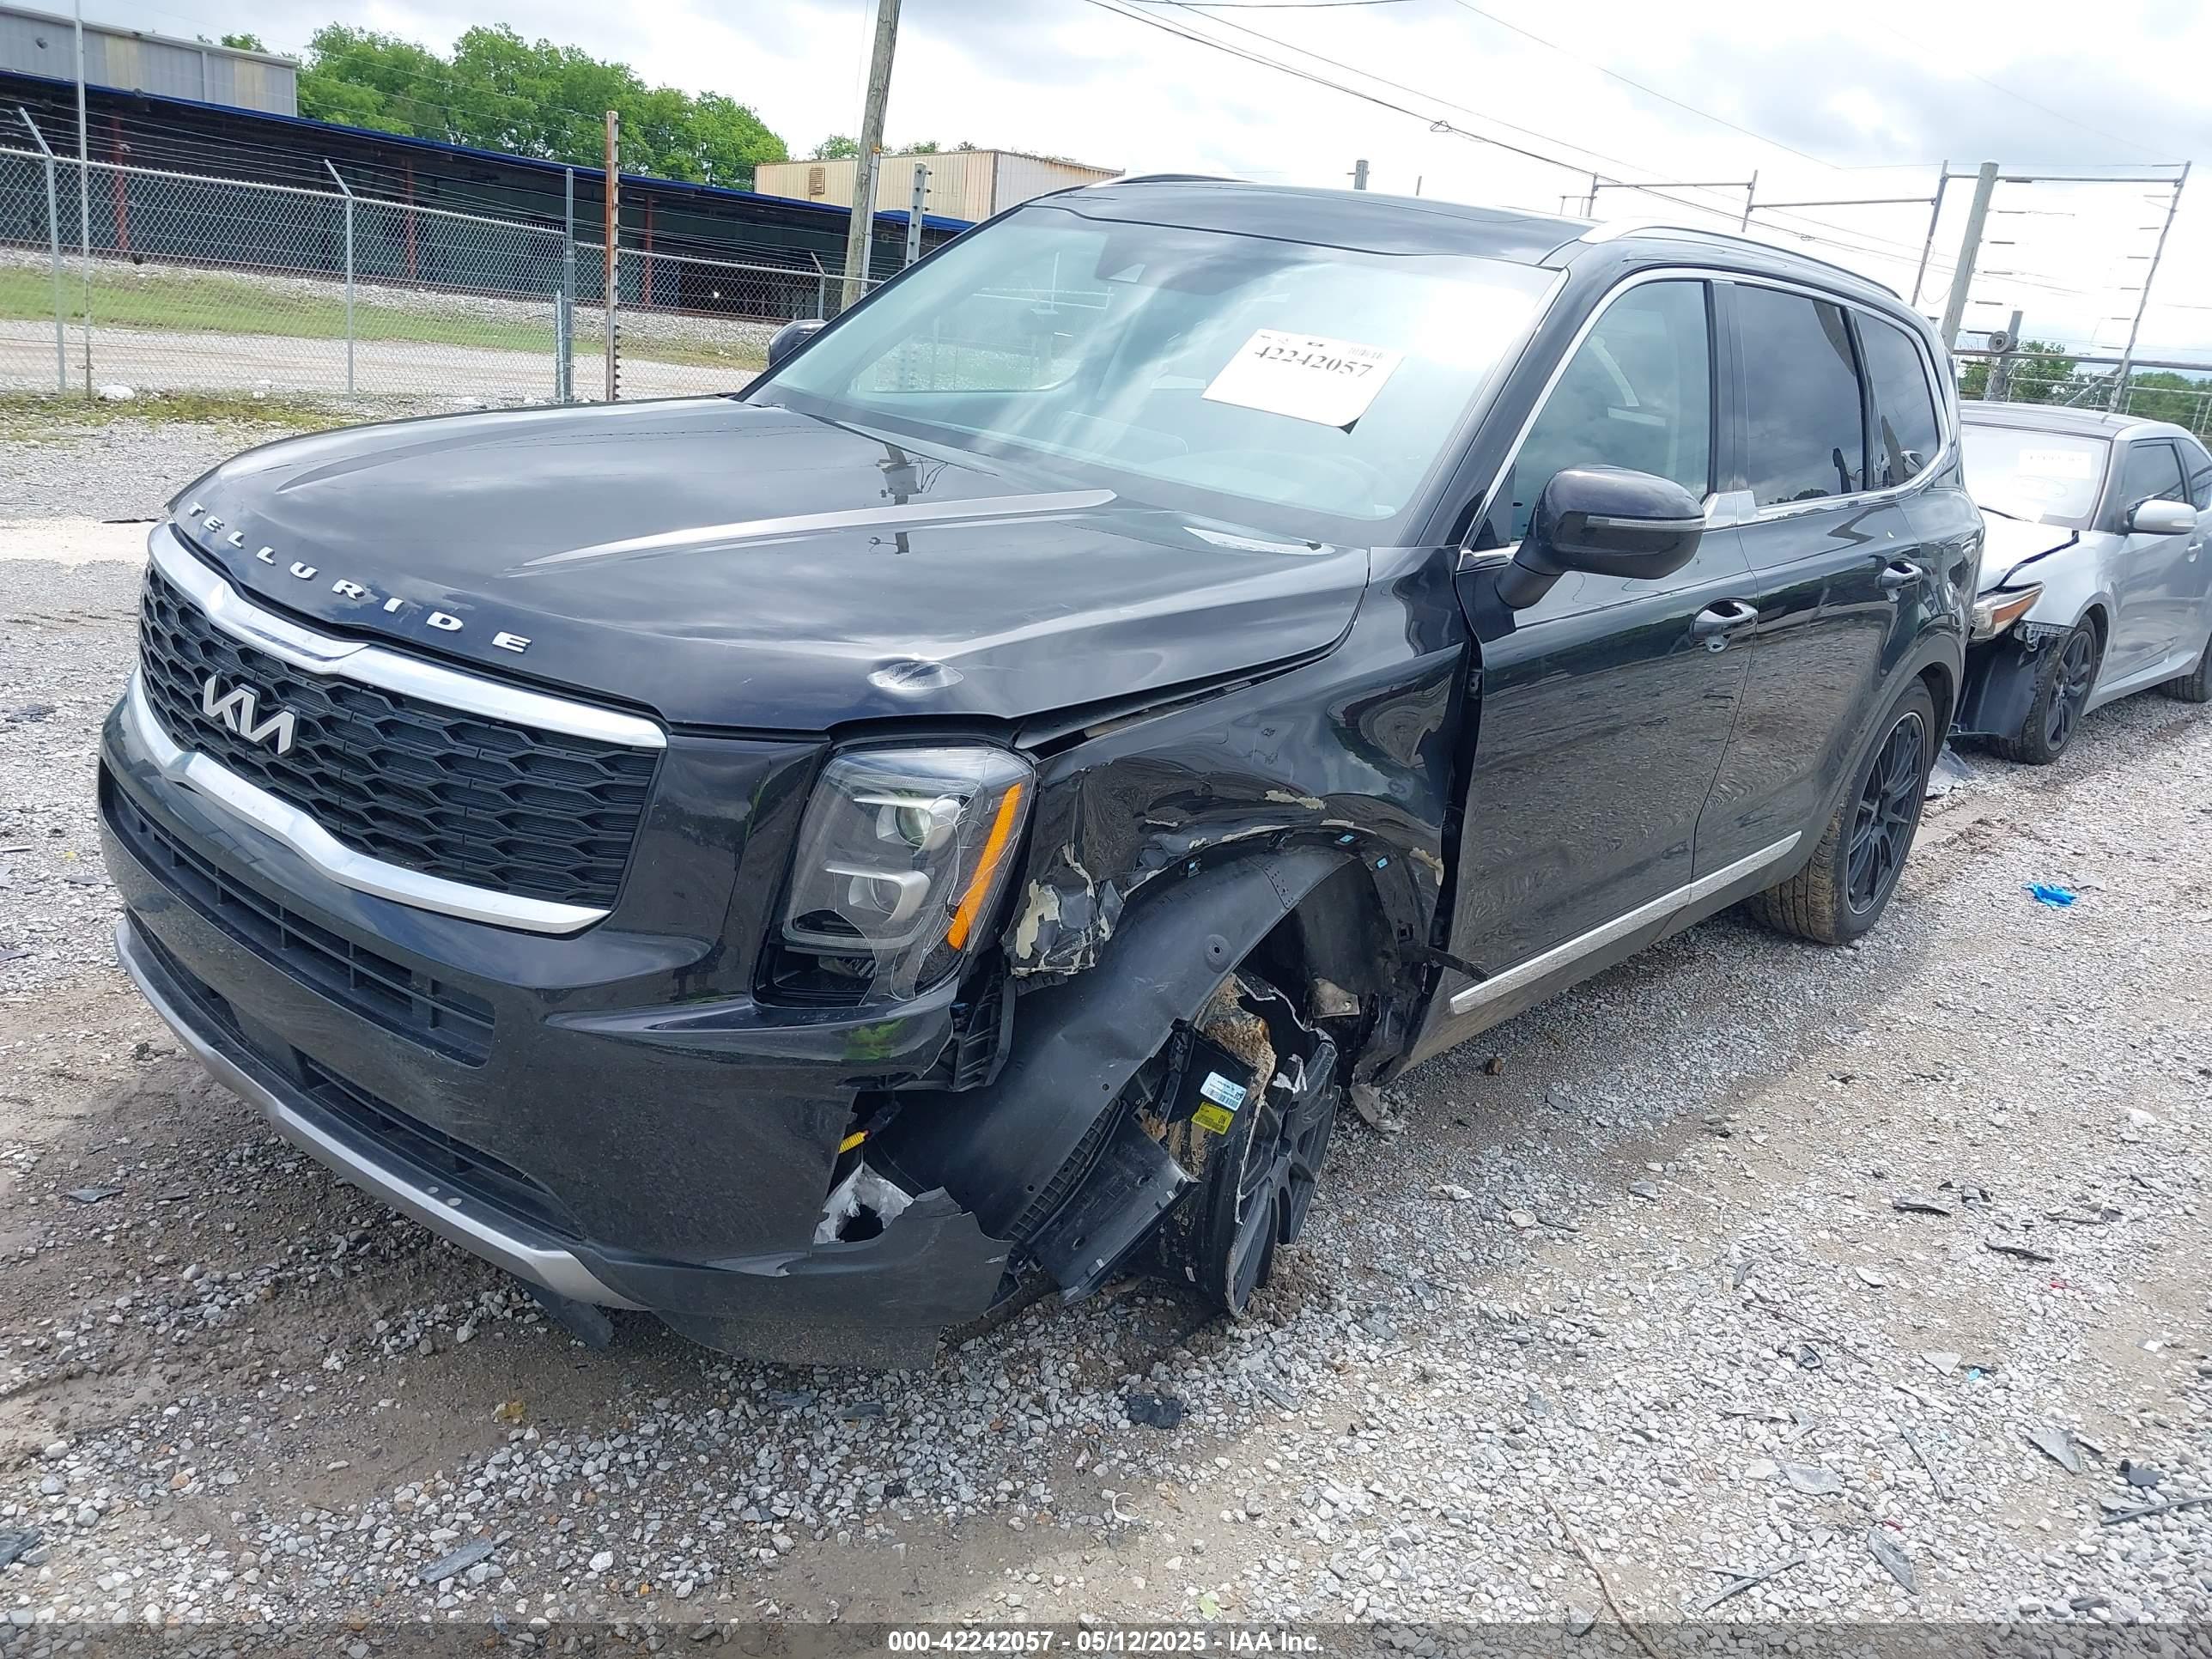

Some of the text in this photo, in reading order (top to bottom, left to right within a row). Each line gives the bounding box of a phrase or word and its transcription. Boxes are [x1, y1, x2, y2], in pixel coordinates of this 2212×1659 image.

[1254, 345, 1374, 377] 42242057
[187, 501, 533, 653] TELLURIDE
[202, 673, 299, 756] KIA
